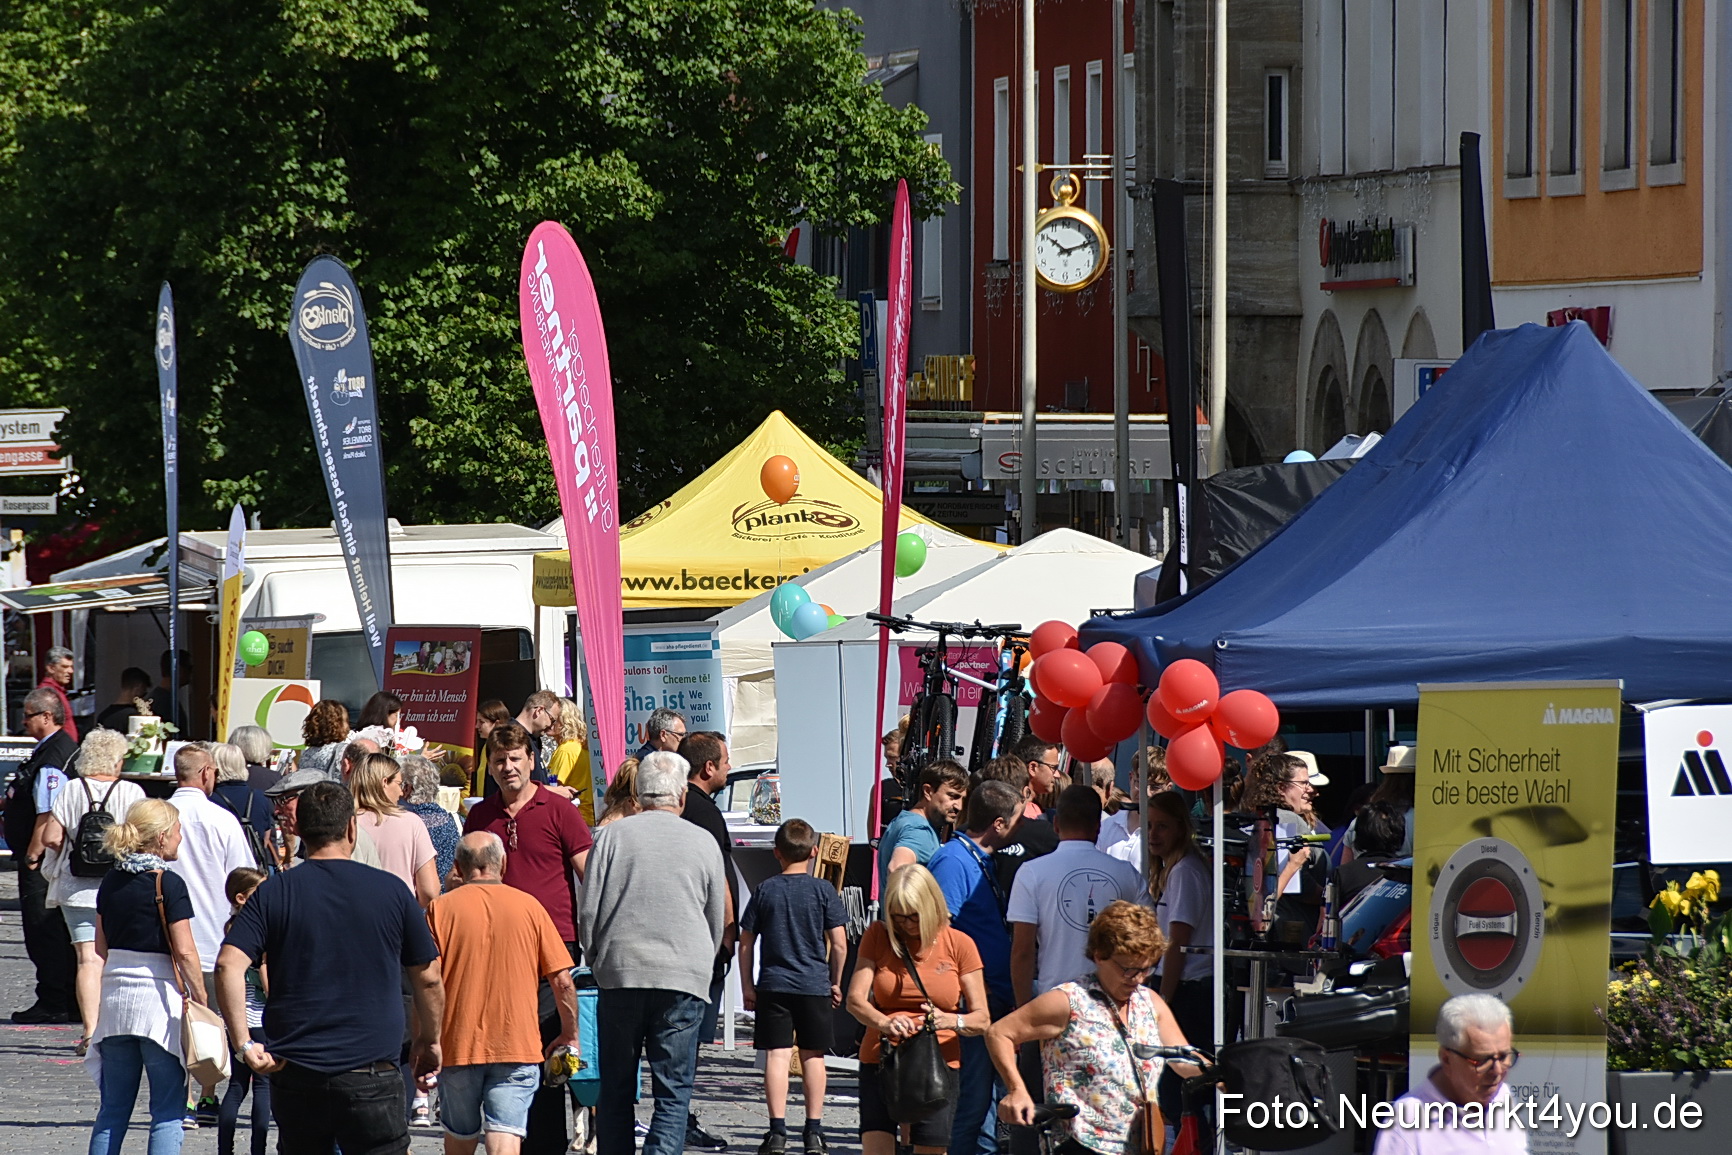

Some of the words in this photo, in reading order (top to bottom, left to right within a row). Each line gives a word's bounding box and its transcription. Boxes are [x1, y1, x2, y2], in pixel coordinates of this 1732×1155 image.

[862, 302, 872, 360] P
[1041, 459, 1151, 475] SCHLIRF
[3, 499, 50, 512] Rosengasse
[937, 502, 999, 510] NORDBAYERISCHE
[744, 509, 817, 532] plank
[731, 532, 772, 542] Bäckerei
[819, 528, 865, 540] Konditorei
[620, 568, 810, 591] ww.baecker
[624, 665, 651, 676] oulons
[653, 665, 668, 675] toi!
[663, 675, 697, 685] Chceme
[410, 689, 424, 702] bin
[424, 689, 437, 702] ich
[437, 689, 467, 702] Mensch
[663, 690, 685, 710] ist
[689, 690, 703, 699] We
[690, 702, 712, 711] want
[405, 708, 426, 722] kann
[427, 709, 439, 722] ich
[439, 709, 459, 722] sein!
[690, 713, 709, 725] you!
[1558, 707, 1615, 725] MAGNA
[1433, 749, 1461, 774] Mit
[1467, 747, 1561, 774] Sicherheit
[1432, 780, 1460, 806] die
[1466, 779, 1519, 805] beste
[1525, 778, 1571, 804] Wahl
[1480, 845, 1498, 854] Diesel
[1468, 920, 1481, 929] Fuel
[1482, 920, 1506, 930] Systems
[1533, 912, 1541, 939] Benzin
[1510, 1082, 1539, 1102] ergie
